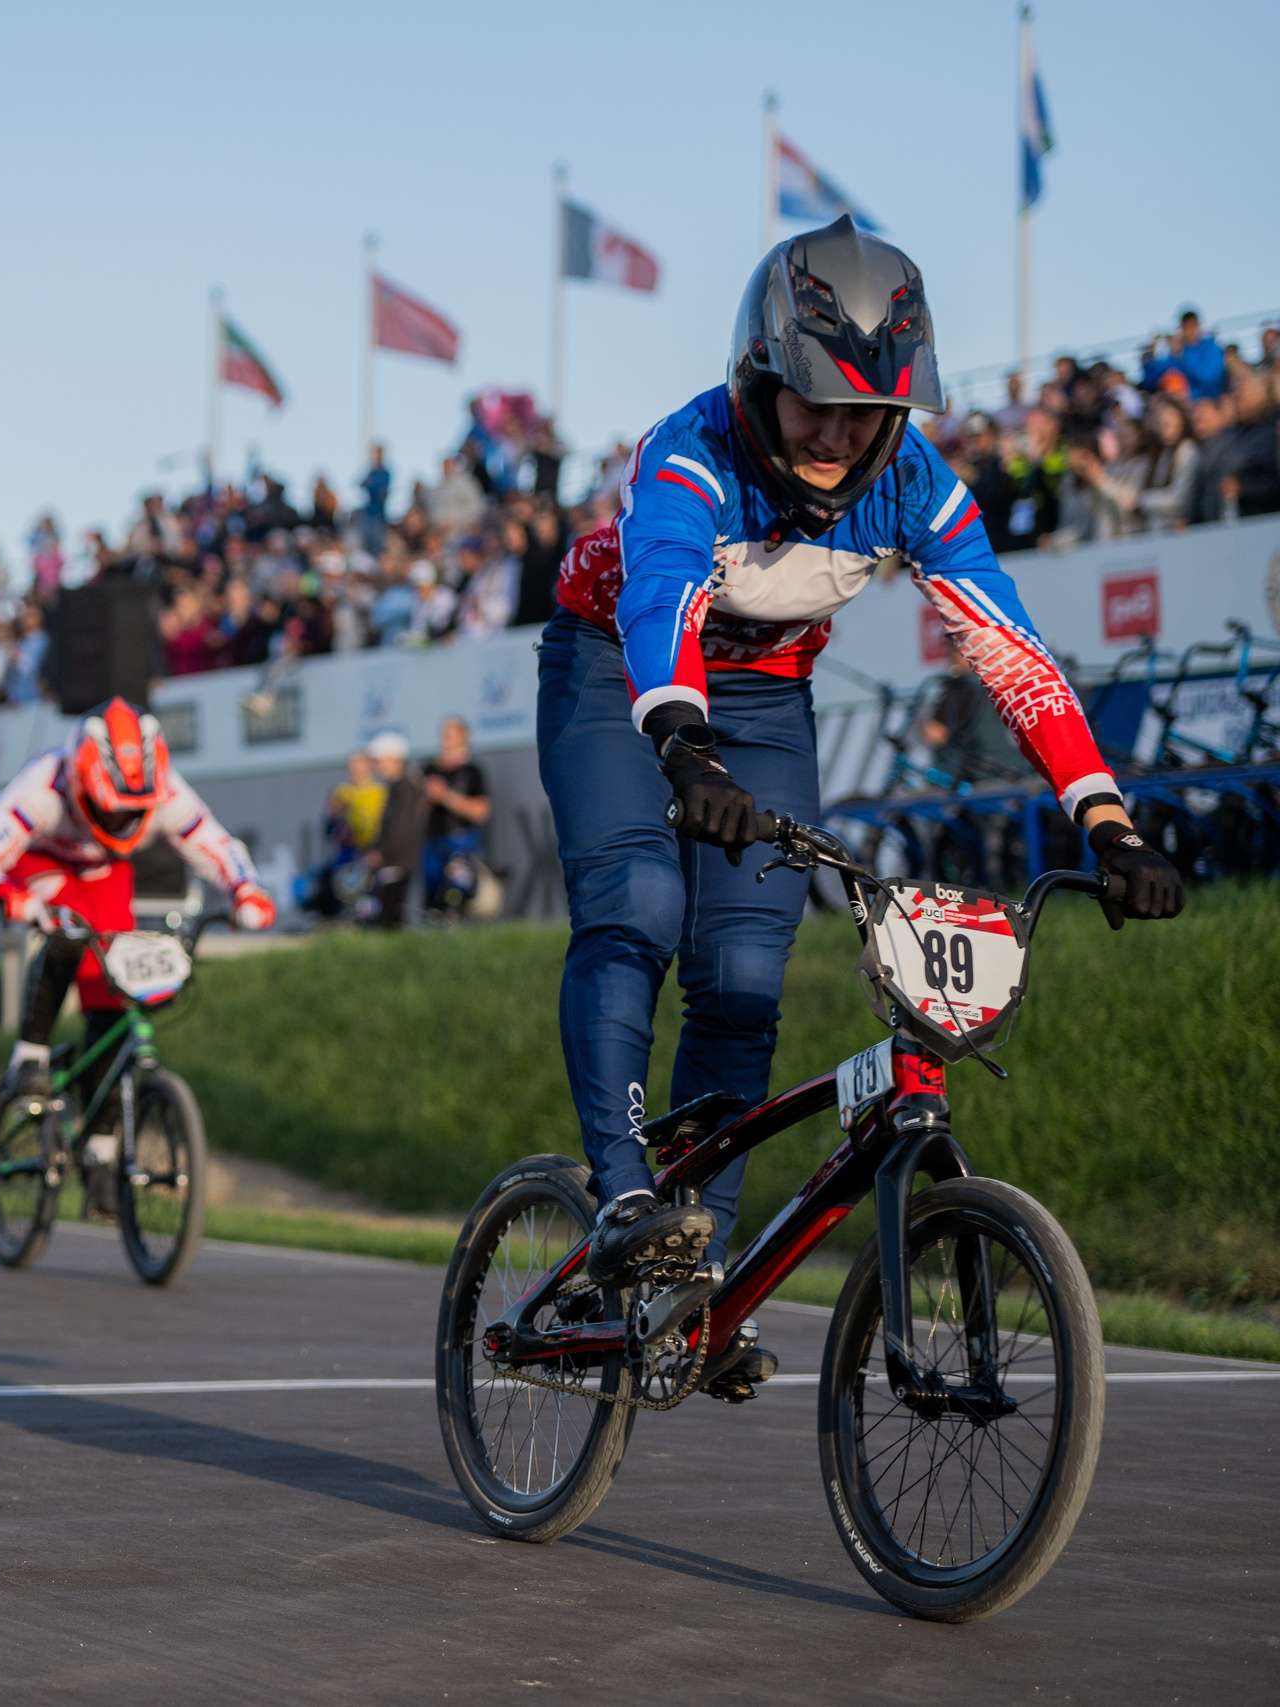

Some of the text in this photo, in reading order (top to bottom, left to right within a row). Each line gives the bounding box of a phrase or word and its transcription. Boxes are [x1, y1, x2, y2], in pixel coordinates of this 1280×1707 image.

[935, 883, 964, 903] box
[925, 908, 943, 919] UCI
[924, 929, 974, 994] 89
[854, 1540, 883, 1574] FASTR
